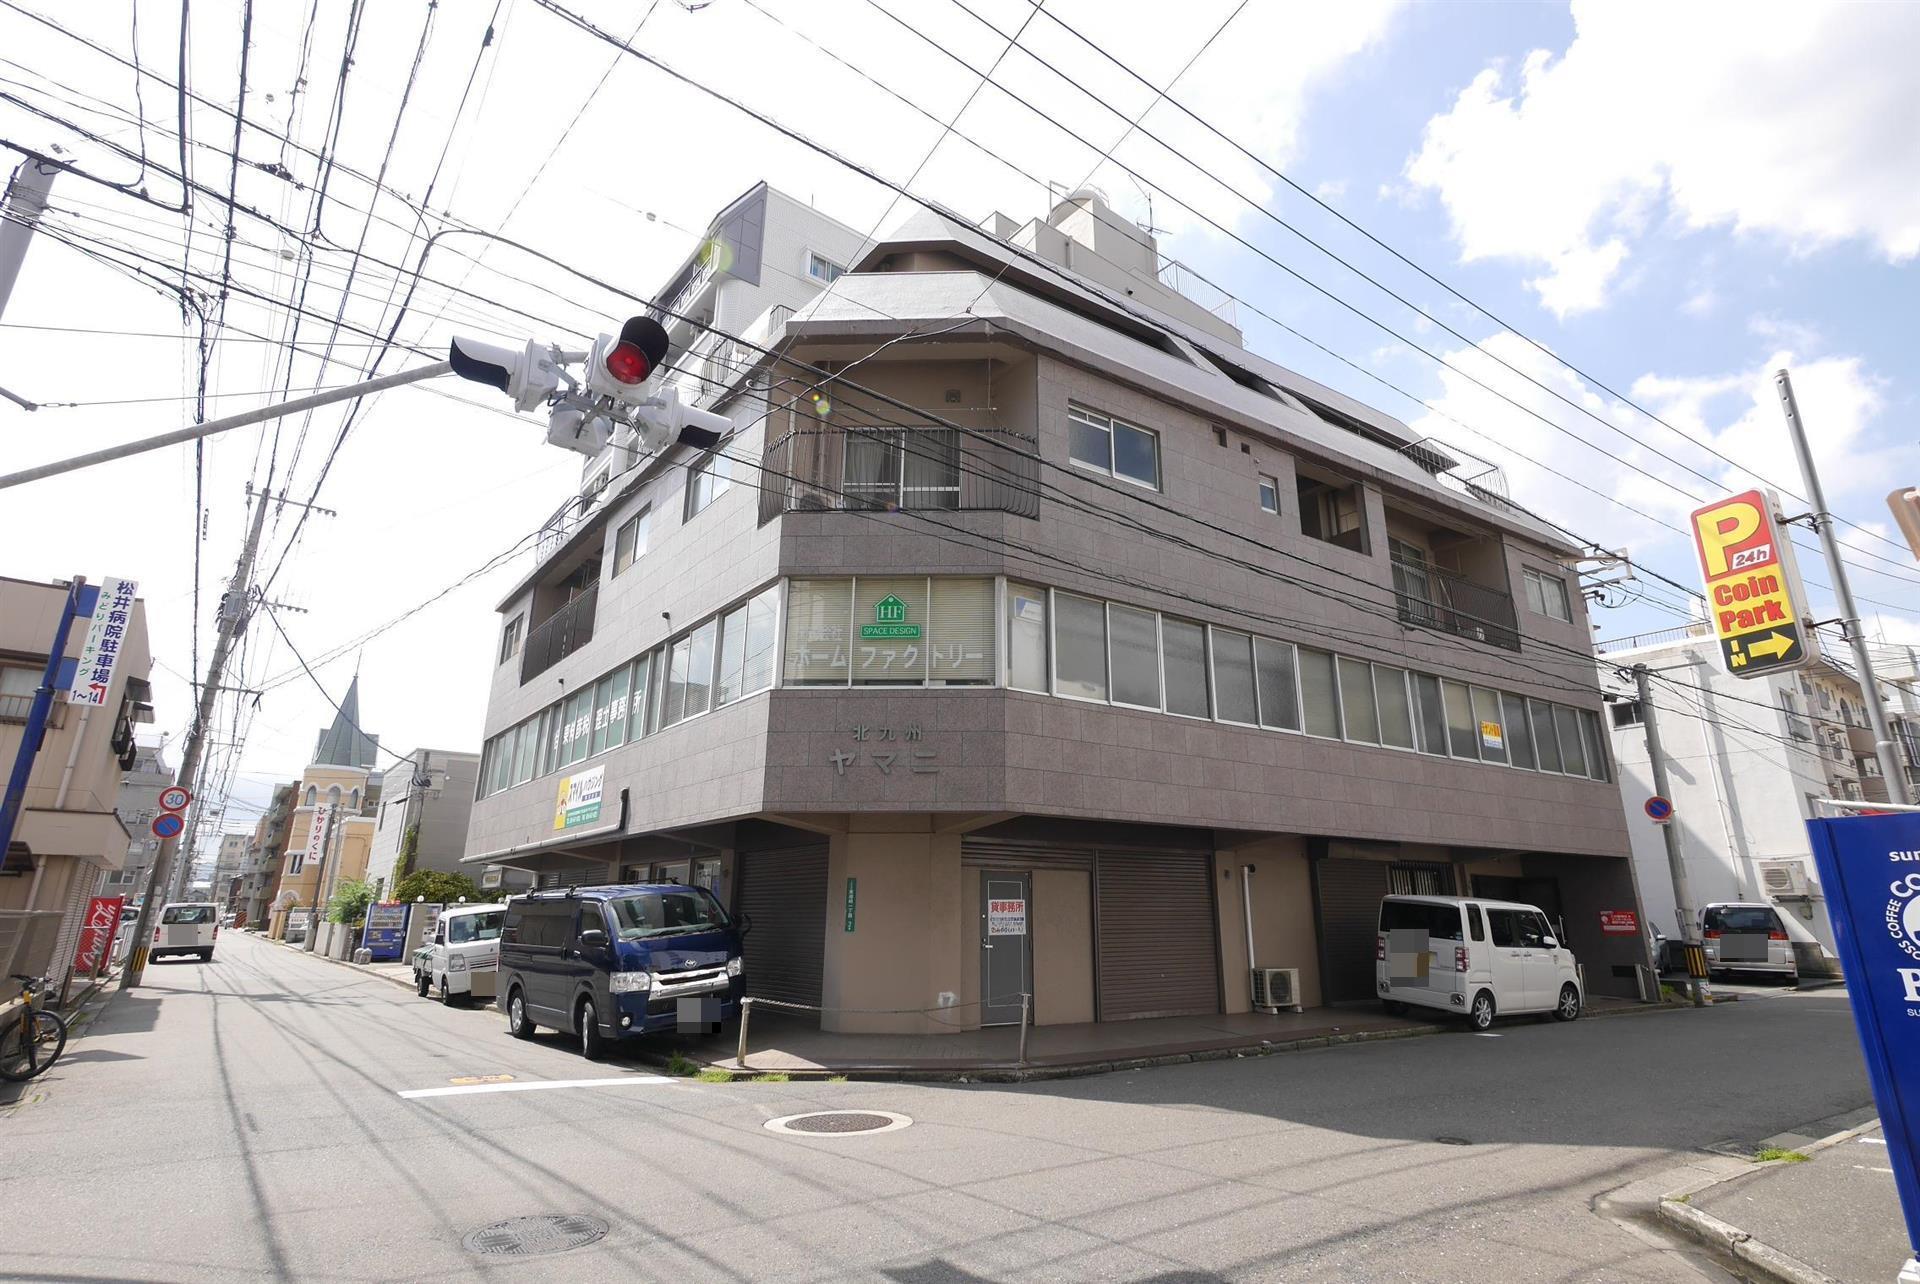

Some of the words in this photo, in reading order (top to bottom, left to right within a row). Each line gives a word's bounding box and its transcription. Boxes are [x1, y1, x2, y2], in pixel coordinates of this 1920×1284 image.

[1695, 502, 1761, 577] P
[1735, 549, 1768, 567] 24h
[1713, 574, 1780, 607] Coin
[880, 606, 903, 619] HF
[1718, 600, 1786, 633] Park
[90, 580, 135, 684] 松井病院駐車場
[863, 627, 888, 635] SPACE
[889, 627, 917, 635] DESIGN
[853, 724, 923, 742] 北九州
[165, 794, 184, 806] 30
[1885, 899, 1902, 938] COFFEE
